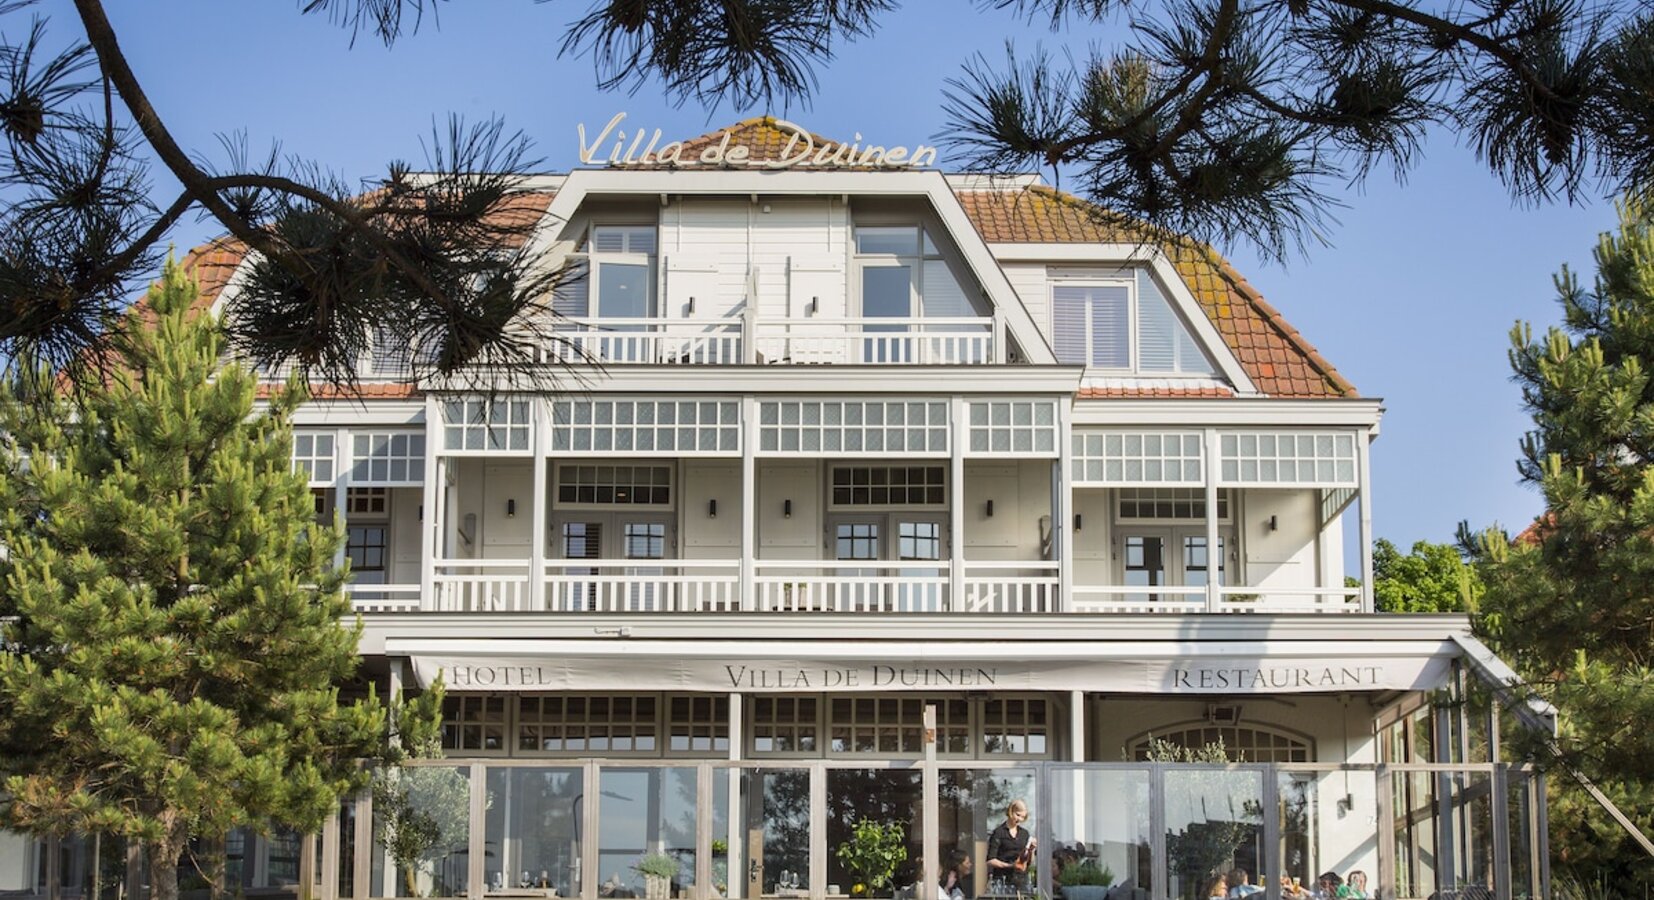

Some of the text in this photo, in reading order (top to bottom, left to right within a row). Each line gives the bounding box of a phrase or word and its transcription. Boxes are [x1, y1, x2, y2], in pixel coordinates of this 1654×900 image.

[577, 112, 937, 168] Villa de Duinen
[453, 666, 551, 686] HOTEL
[725, 665, 996, 688] VILLA DE DUINEN
[1173, 666, 1383, 689] RESTAURANT
